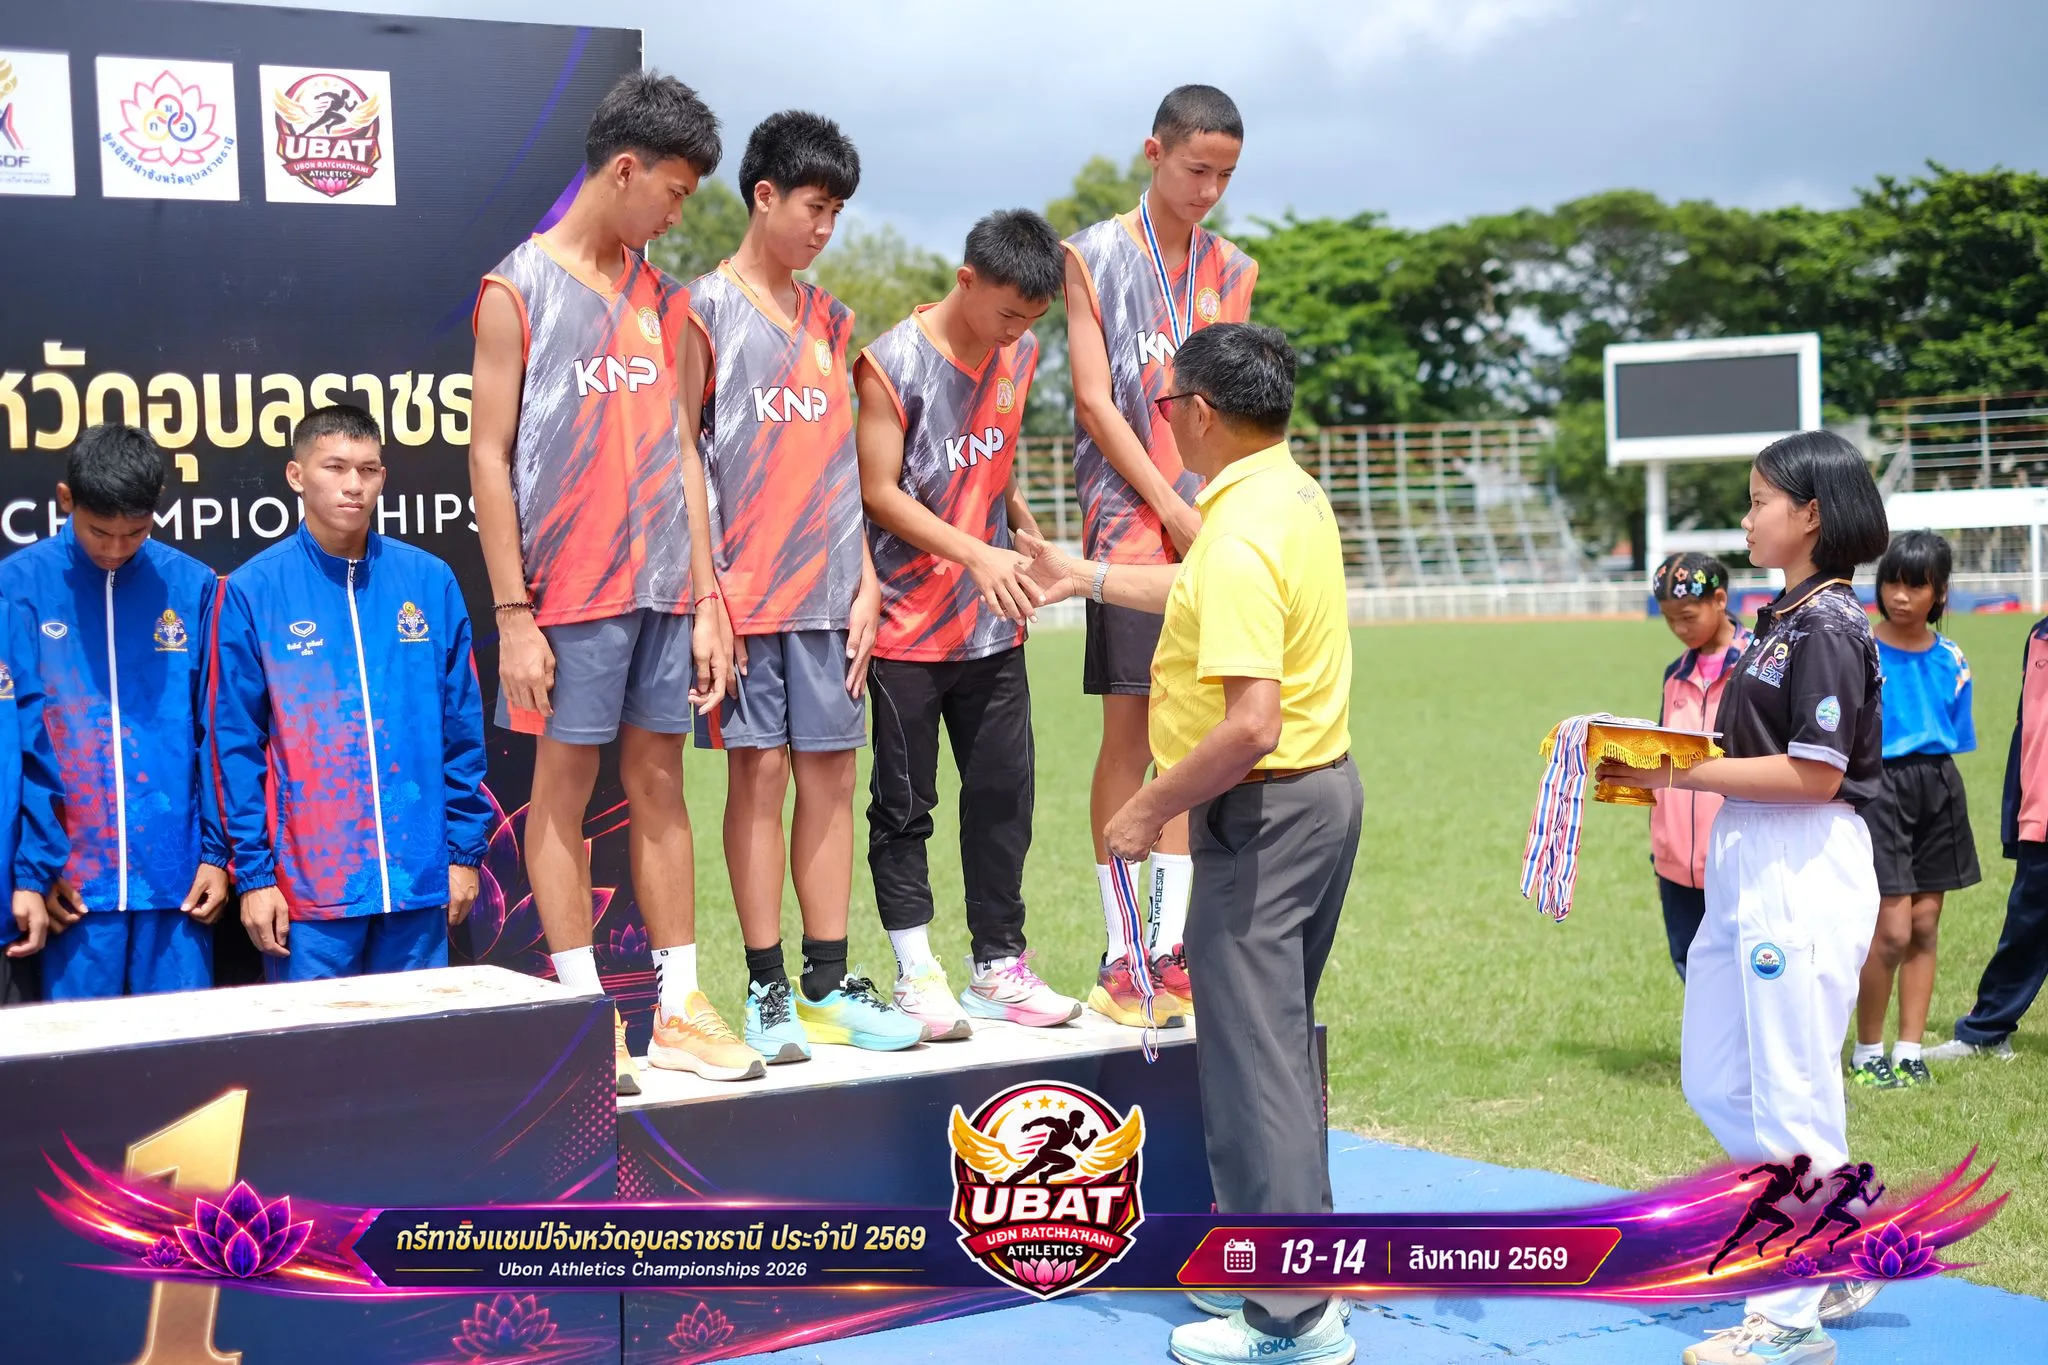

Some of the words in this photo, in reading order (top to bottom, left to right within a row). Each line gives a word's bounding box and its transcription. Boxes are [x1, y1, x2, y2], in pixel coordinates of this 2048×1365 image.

[0, 155, 31, 168] DF
[285, 135, 373, 162] UBAT
[309, 170, 353, 178] ATHLETICS
[573, 354, 659, 398] KNP
[752, 386, 829, 423] KNP
[944, 426, 1006, 473] KNP
[1153, 867, 1166, 922] TAPEDESIGN
[1248, 1336, 1297, 1358] HOKA
